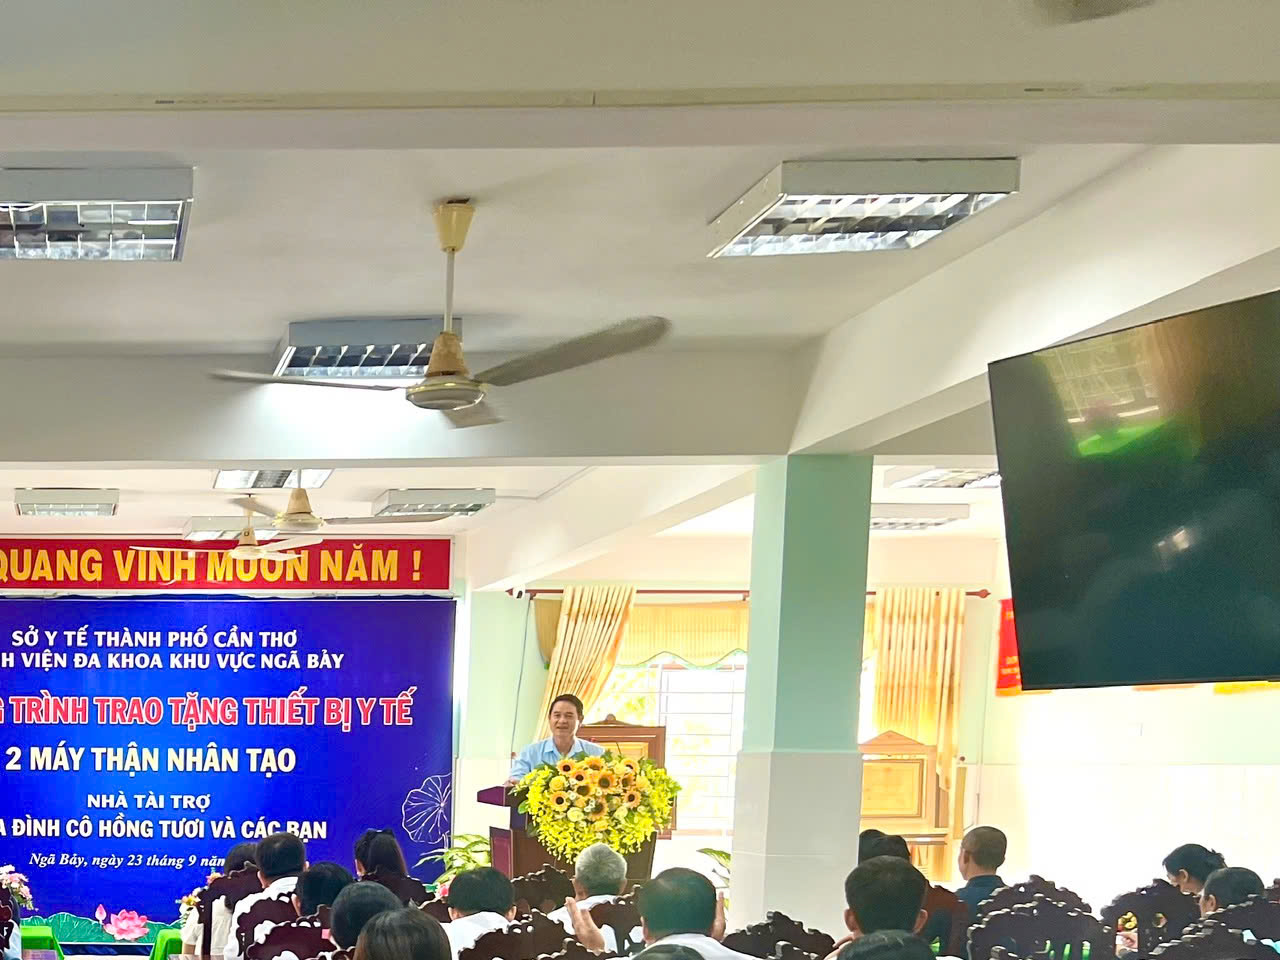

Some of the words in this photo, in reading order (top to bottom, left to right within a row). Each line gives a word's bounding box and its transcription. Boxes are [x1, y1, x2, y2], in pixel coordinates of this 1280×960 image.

[113, 550, 196, 582] VINH
[320, 543, 398, 582] NĂM
[11, 625, 39, 647] SỞ
[45, 631, 58, 647] Y
[64, 625, 89, 647] TẾ
[94, 627, 161, 647] THÀNH
[168, 625, 208, 648] PHỐ
[259, 630, 298, 648] THƠ
[21, 649, 67, 672] VIỆN
[73, 653, 101, 668] ĐA
[107, 653, 163, 668] KHOA
[170, 653, 210, 669] KHU
[216, 651, 256, 672] VỰC
[260, 651, 300, 669] NGÃ
[307, 649, 344, 669] BẢY
[8, 690, 88, 724] TRÌNH
[93, 697, 164, 725] TRAO
[168, 692, 238, 732] TẶNG
[243, 686, 320, 725] THIẾT
[324, 697, 351, 732] BỊ
[356, 697, 376, 725] Y
[379, 686, 417, 725] TẾ
[5, 747, 21, 771] 2
[30, 740, 85, 771] MÁY
[91, 741, 159, 777] THẬN
[167, 742, 239, 772] NHÂN
[246, 748, 296, 778] TẠO
[87, 791, 128, 809] NHÀ
[134, 791, 164, 809] TÀI
[170, 794, 211, 813] TRỢ
[11, 814, 60, 837] ĐÌNH
[66, 815, 93, 837] CÔ
[98, 812, 153, 838] HỒNG
[159, 818, 205, 838] TƯƠI
[211, 816, 236, 838] VÀ
[241, 816, 281, 838] CÁC
[286, 821, 327, 843] BẠN
[29, 853, 55, 868] Ngã
[59, 853, 88, 868] Bảy,
[92, 854, 123, 869] ngày
[127, 854, 143, 866] 23
[146, 854, 185, 869] tháng
[188, 854, 197, 867] 9
